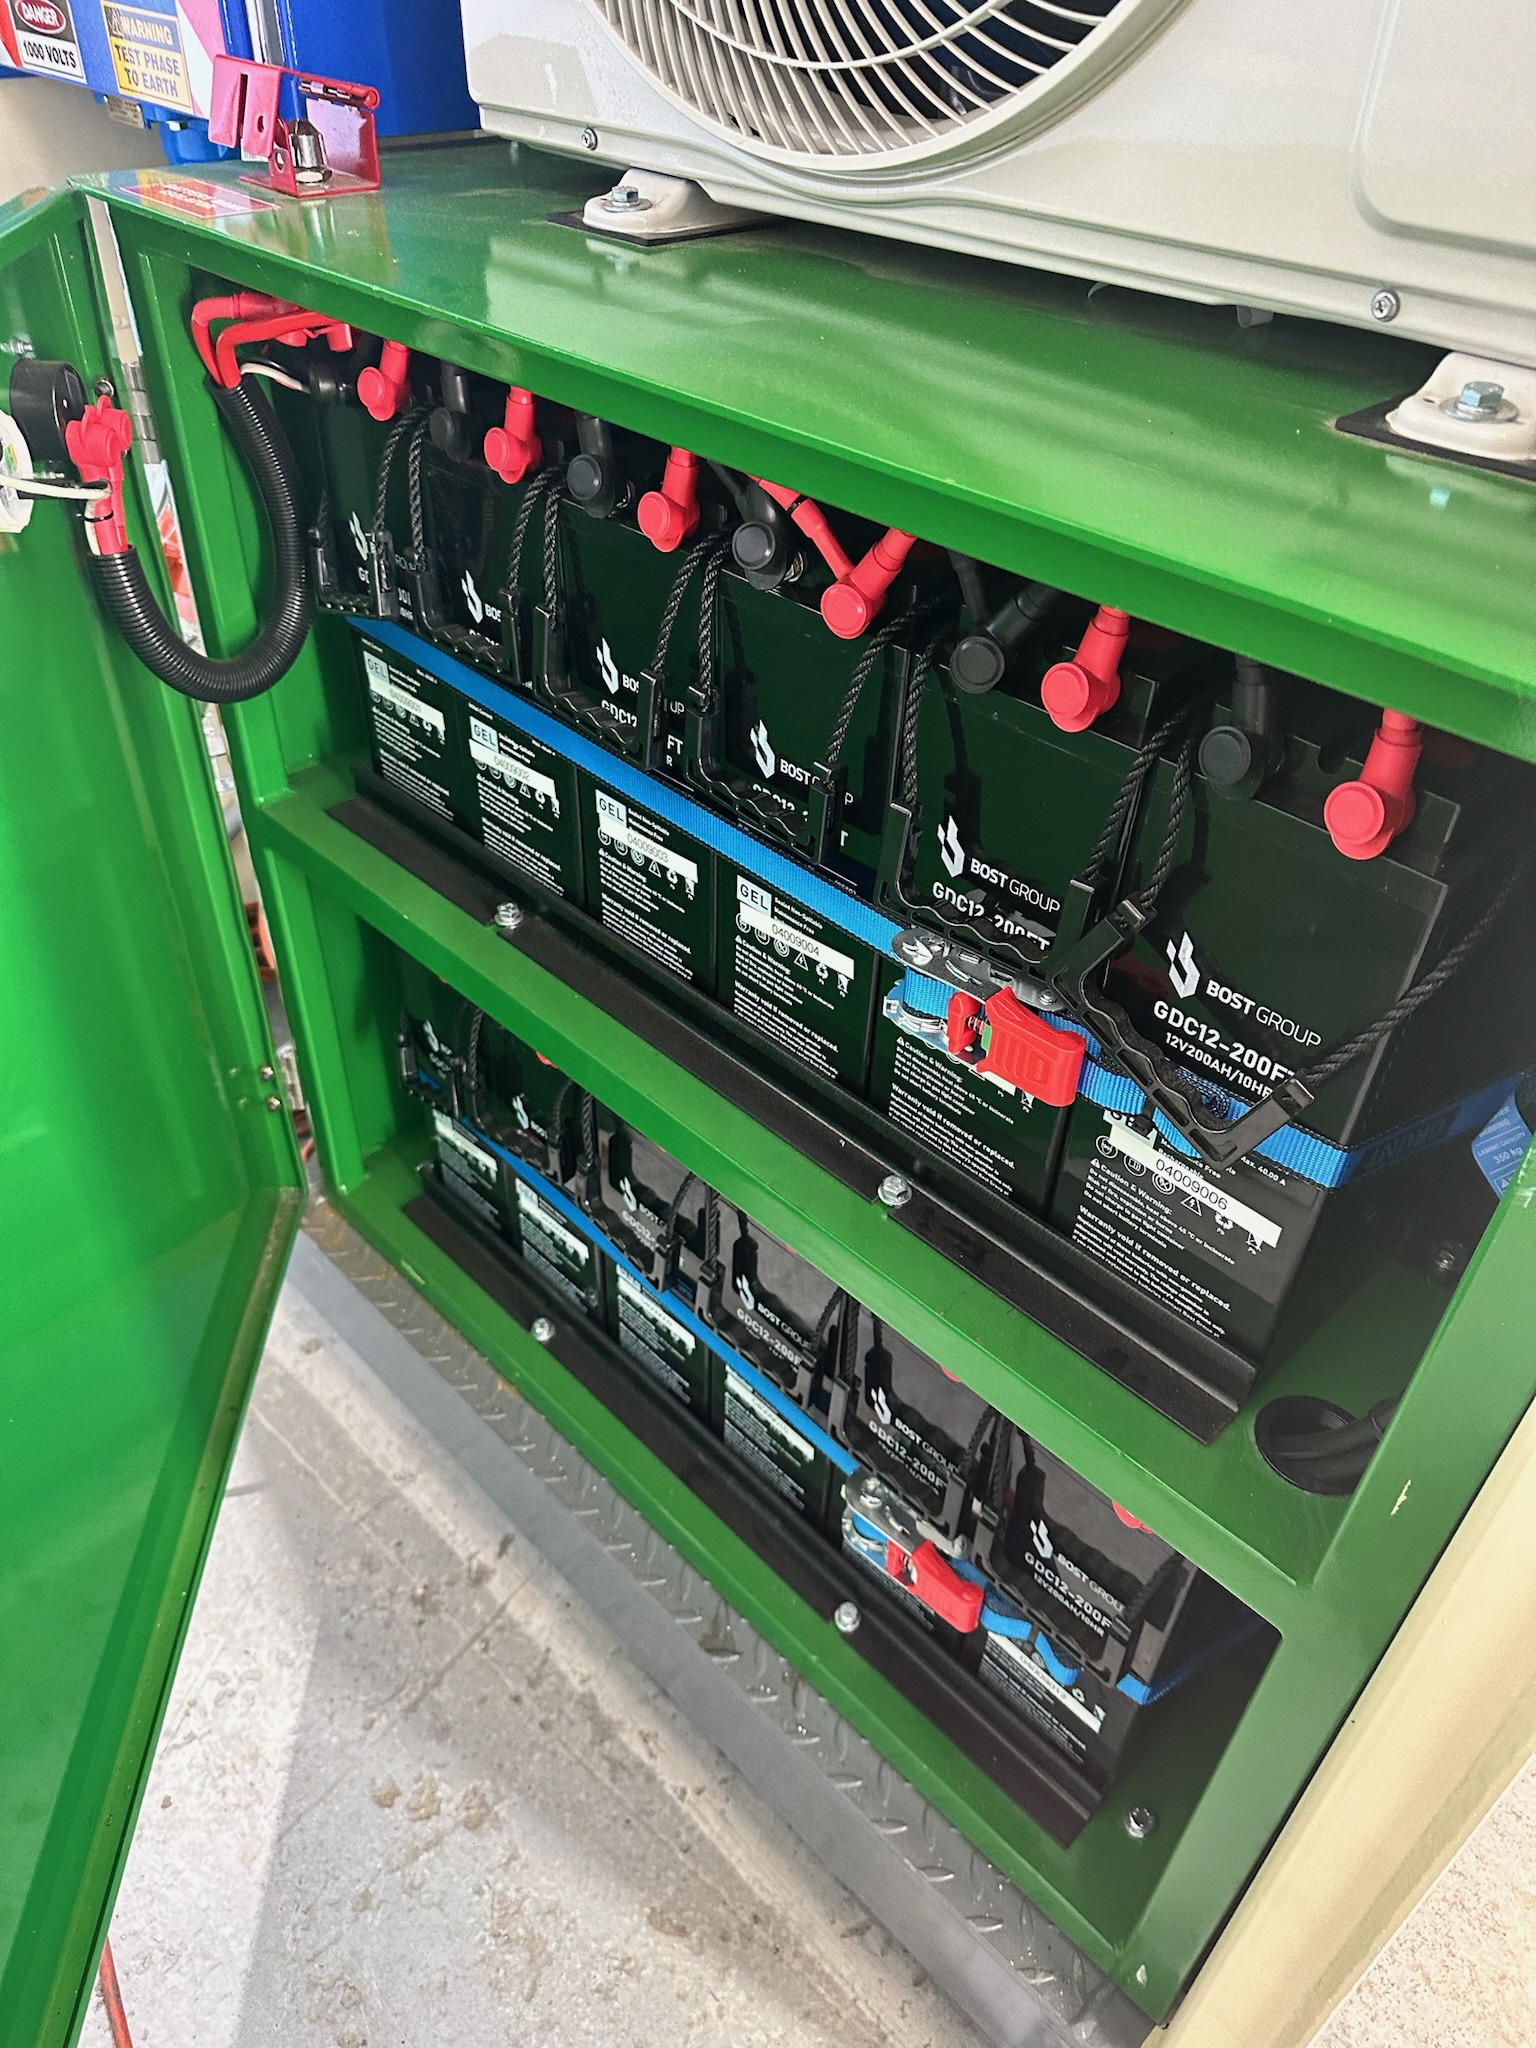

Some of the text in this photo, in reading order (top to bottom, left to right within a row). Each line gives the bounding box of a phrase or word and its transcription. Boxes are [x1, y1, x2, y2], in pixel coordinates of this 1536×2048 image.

[21, 0, 60, 27] DANGER
[120, 16, 173, 46] WARNING
[23, 40, 76, 68] 1000 VOLTS
[115, 43, 181, 76] TEST PHASE
[125, 67, 179, 98] TO EARTH
[474, 724, 497, 748] GEL
[599, 798, 625, 822] GEL
[627, 833, 668, 864] 04009003
[740, 884, 768, 911] GEL
[970, 858, 1061, 913] BOST GROUP
[772, 924, 820, 957] 04009004
[1205, 979, 1322, 1047] BOST GROUP
[891, 1081, 1015, 1170] Warranty void if removed or replaced.
[1493, 1147, 1524, 1164] 350 kg
[1100, 1163, 1172, 1216] Caution & Warning:
[1155, 1158, 1229, 1211] 04009006
[1078, 1204, 1232, 1313] Warranty void if removed or replaced.
[757, 1302, 782, 1327] BOST
[895, 1417, 922, 1445] BOST
[1057, 1553, 1125, 1613] BOST GROU
